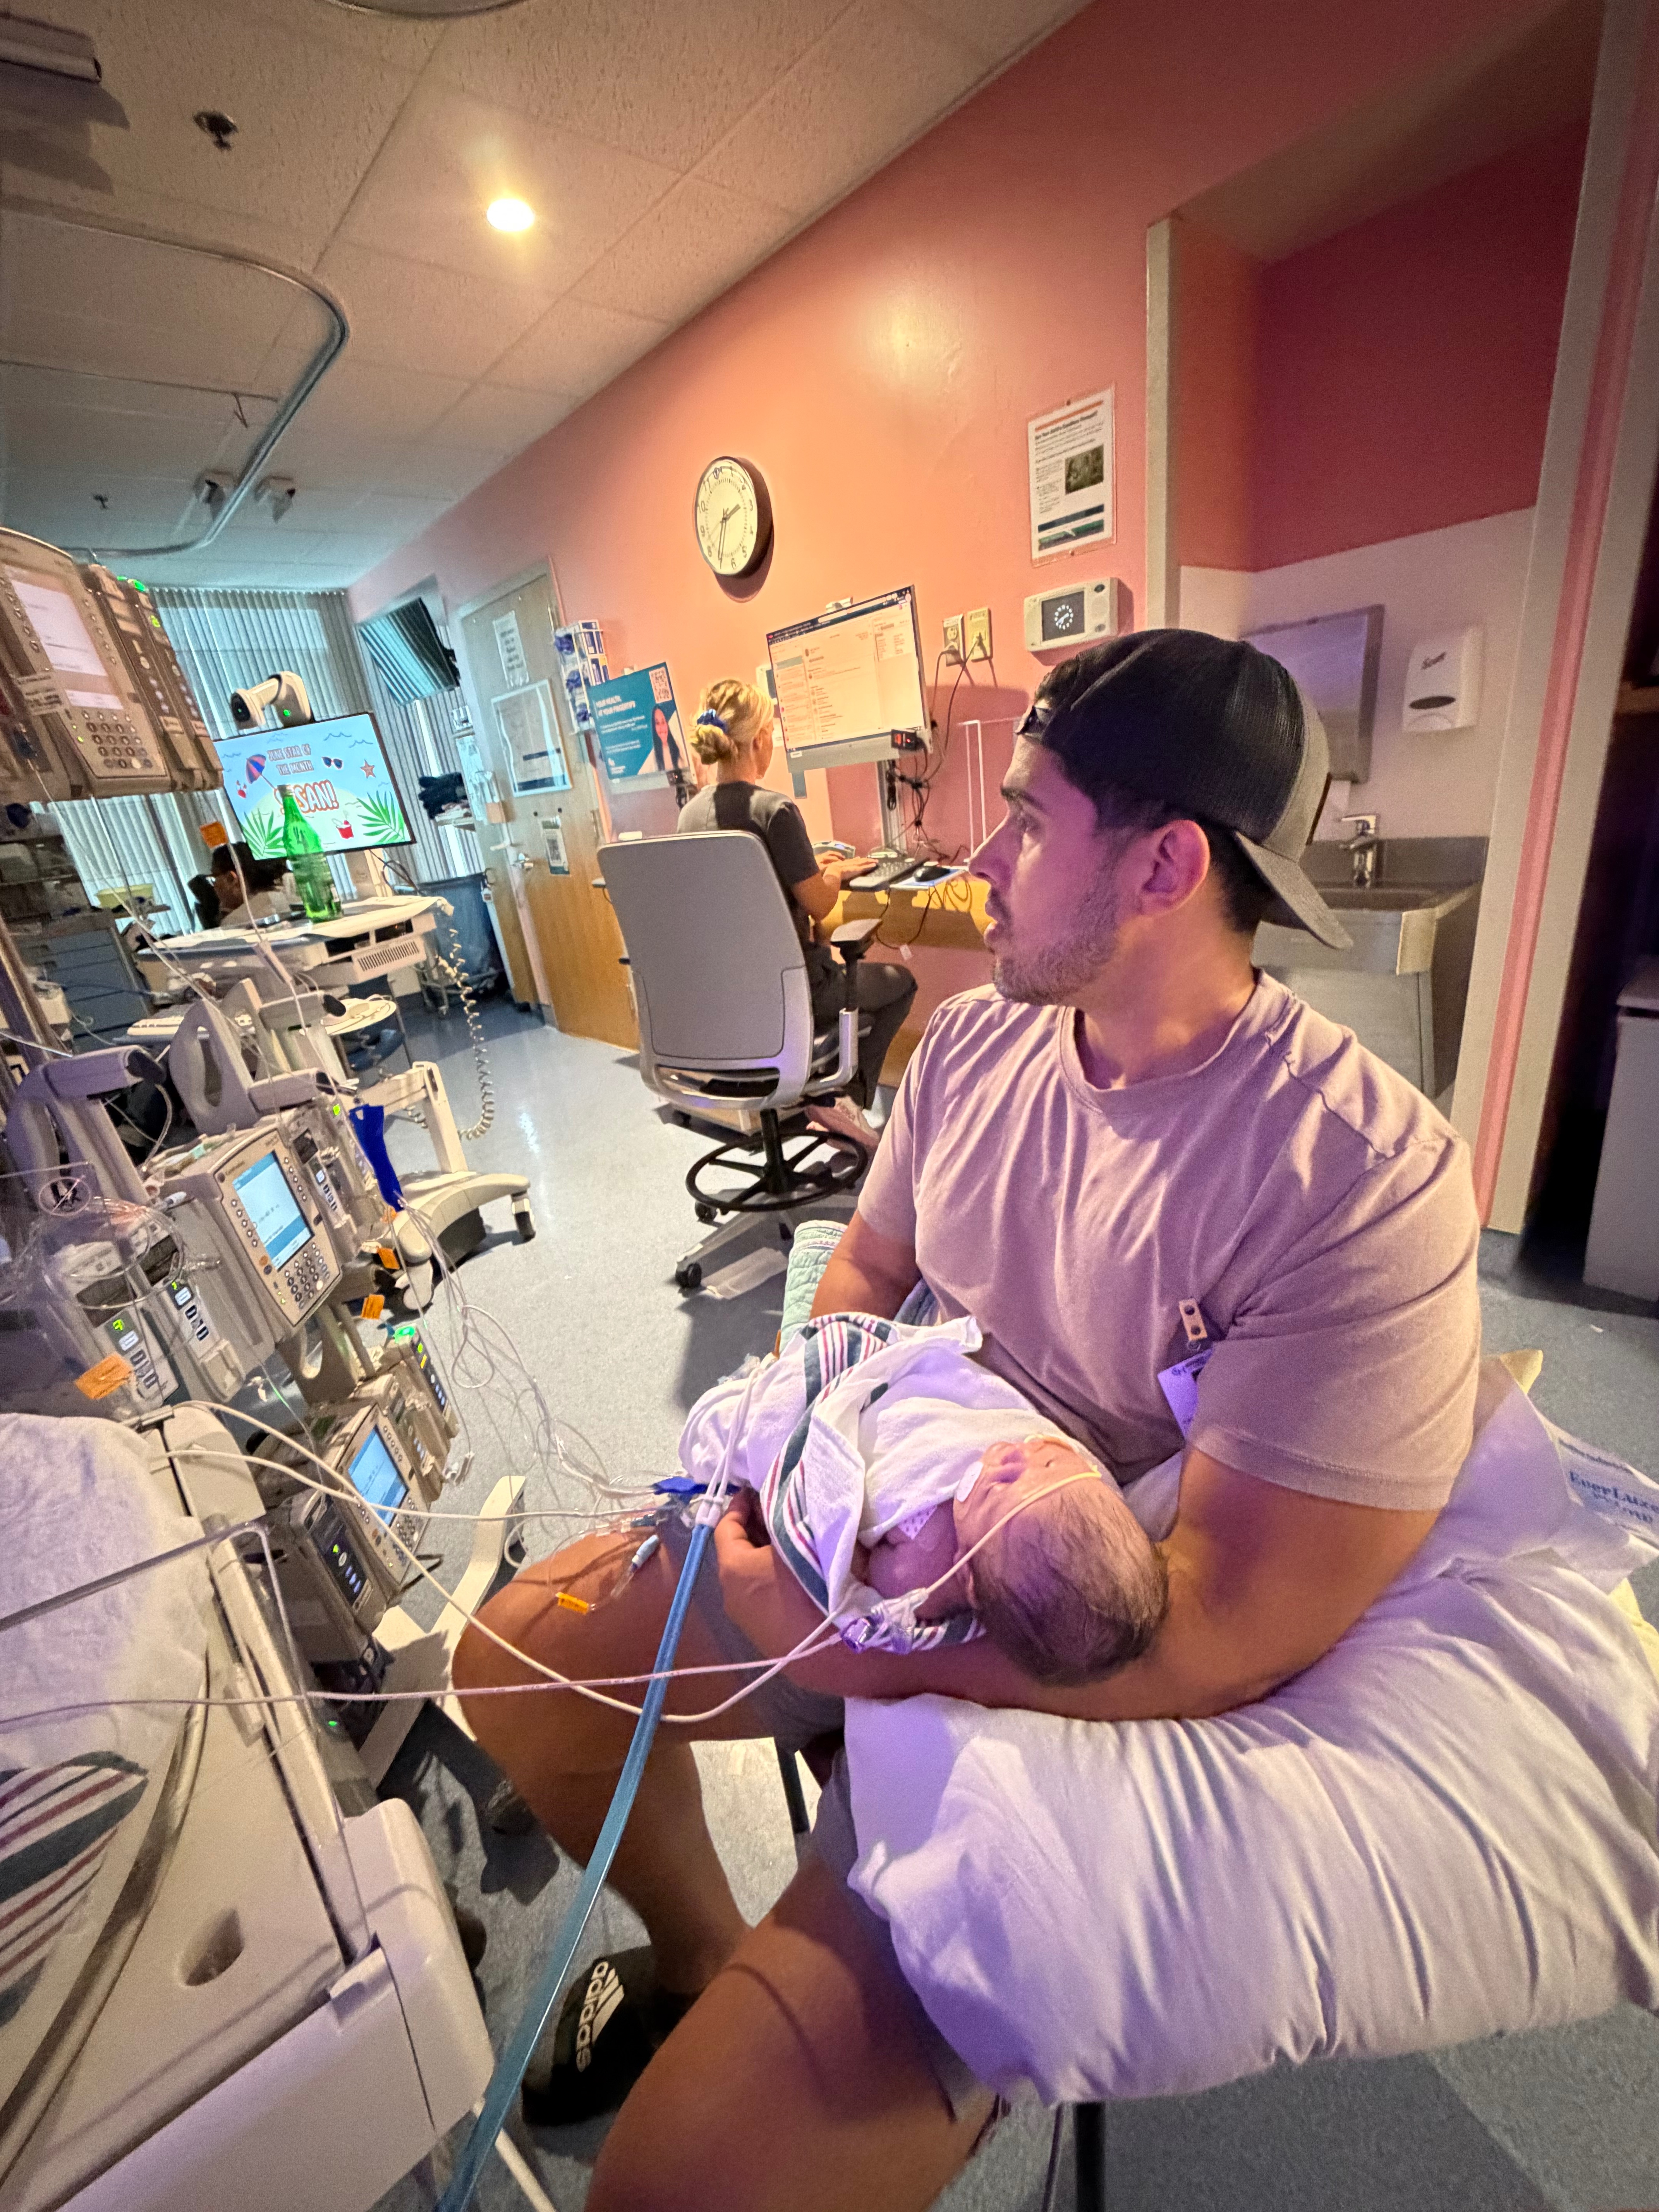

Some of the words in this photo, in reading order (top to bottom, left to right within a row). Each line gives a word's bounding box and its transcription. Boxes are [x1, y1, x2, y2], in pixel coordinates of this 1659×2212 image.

[267, 748, 285, 761] JUNE
[283, 745, 302, 758] STAR
[302, 743, 311, 756] OF
[276, 763, 291, 775] THE
[289, 759, 314, 774] MONTH
[274, 779, 339, 815] SAN!
[576, 1961, 609, 2072] adidas
